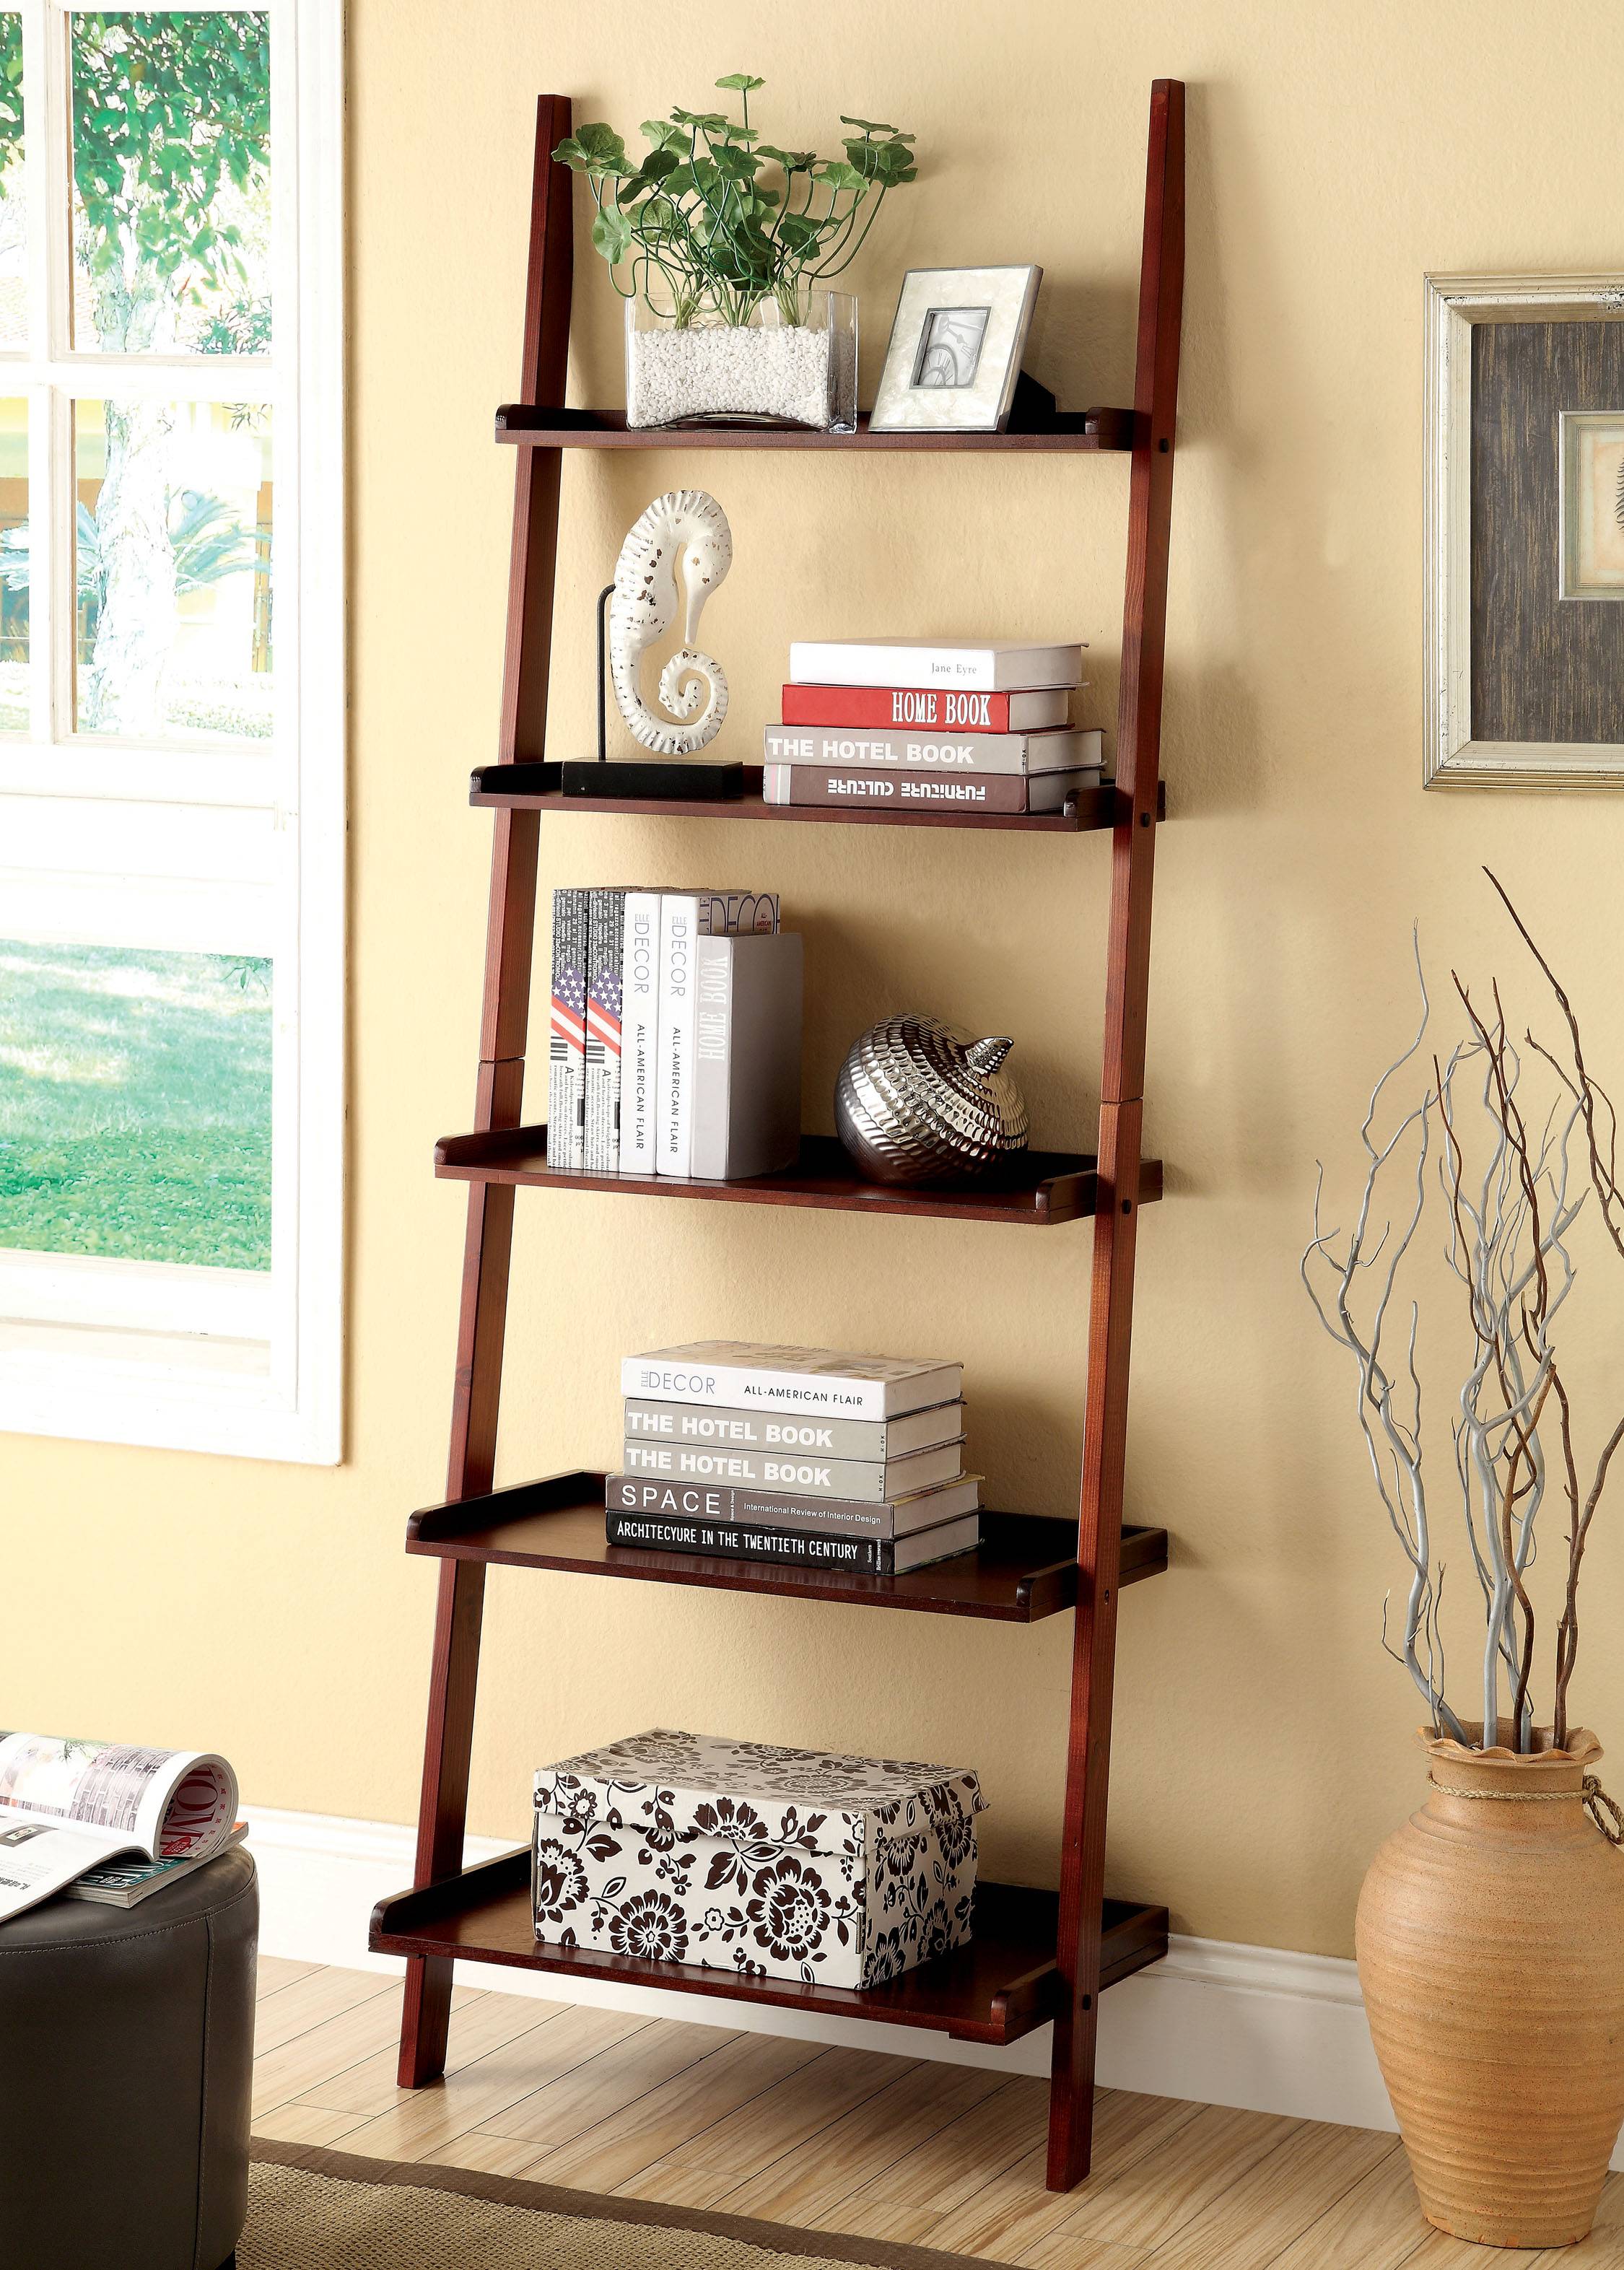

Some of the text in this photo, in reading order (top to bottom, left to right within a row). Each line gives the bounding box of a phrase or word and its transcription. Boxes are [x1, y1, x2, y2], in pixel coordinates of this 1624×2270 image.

[932, 663, 977, 676] Jane Eyre
[892, 691, 991, 725] HOME BOOK
[768, 738, 974, 764] THE HOTEL BOOK
[827, 778, 894, 796] CULTURE
[672, 916, 687, 925] ELLE
[634, 922, 650, 993] DECOR
[671, 925, 686, 996] DECOR
[698, 956, 728, 1061] HOME BOOK
[636, 1024, 645, 1149] ALL-AMERICAN FLAIR
[670, 1027, 681, 1153] ALL-AMERICAN FLAIR
[649, 1371, 715, 1394] DECOR
[744, 1386, 863, 1405] ALL-AMERICAN FLAIR
[628, 1412, 833, 1447] THE HOTEL BOOK
[626, 1449, 831, 1486] THE HOTEL BOOK
[621, 1485, 720, 1514] SPACE
[744, 1503, 789, 1514] International
[790, 1507, 817, 1517] Review
[827, 1511, 854, 1521] Interior
[855, 1514, 881, 1524] Design
[616, 1520, 858, 1560] ARCHITECYURE IN THE TWENTIETH CENTURY
